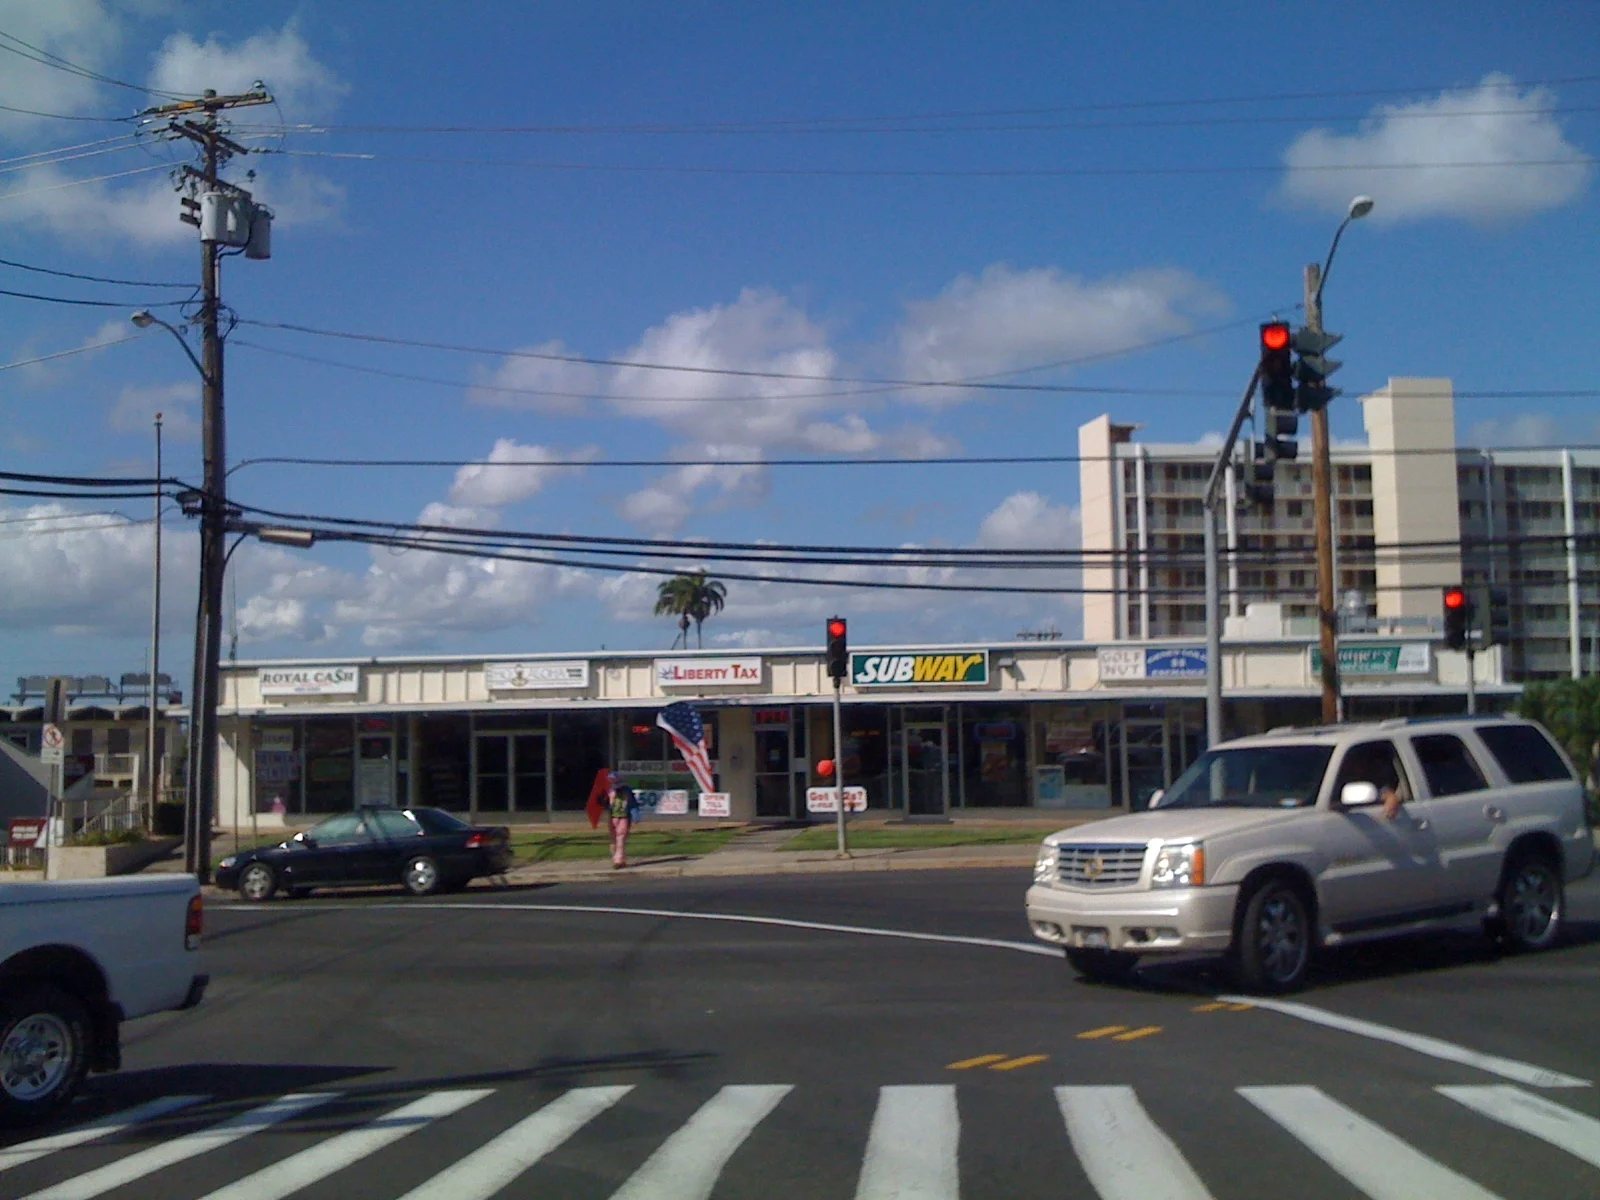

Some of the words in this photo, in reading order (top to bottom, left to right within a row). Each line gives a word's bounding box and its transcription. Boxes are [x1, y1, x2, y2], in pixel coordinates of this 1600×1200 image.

[1101, 651, 1140, 663] GOLF
[673, 666, 728, 680] LIBERTY
[731, 664, 758, 679] TAX
[855, 654, 983, 683] SUBWAY
[1104, 664, 1139, 675] NUT
[263, 672, 309, 683] ROYAL
